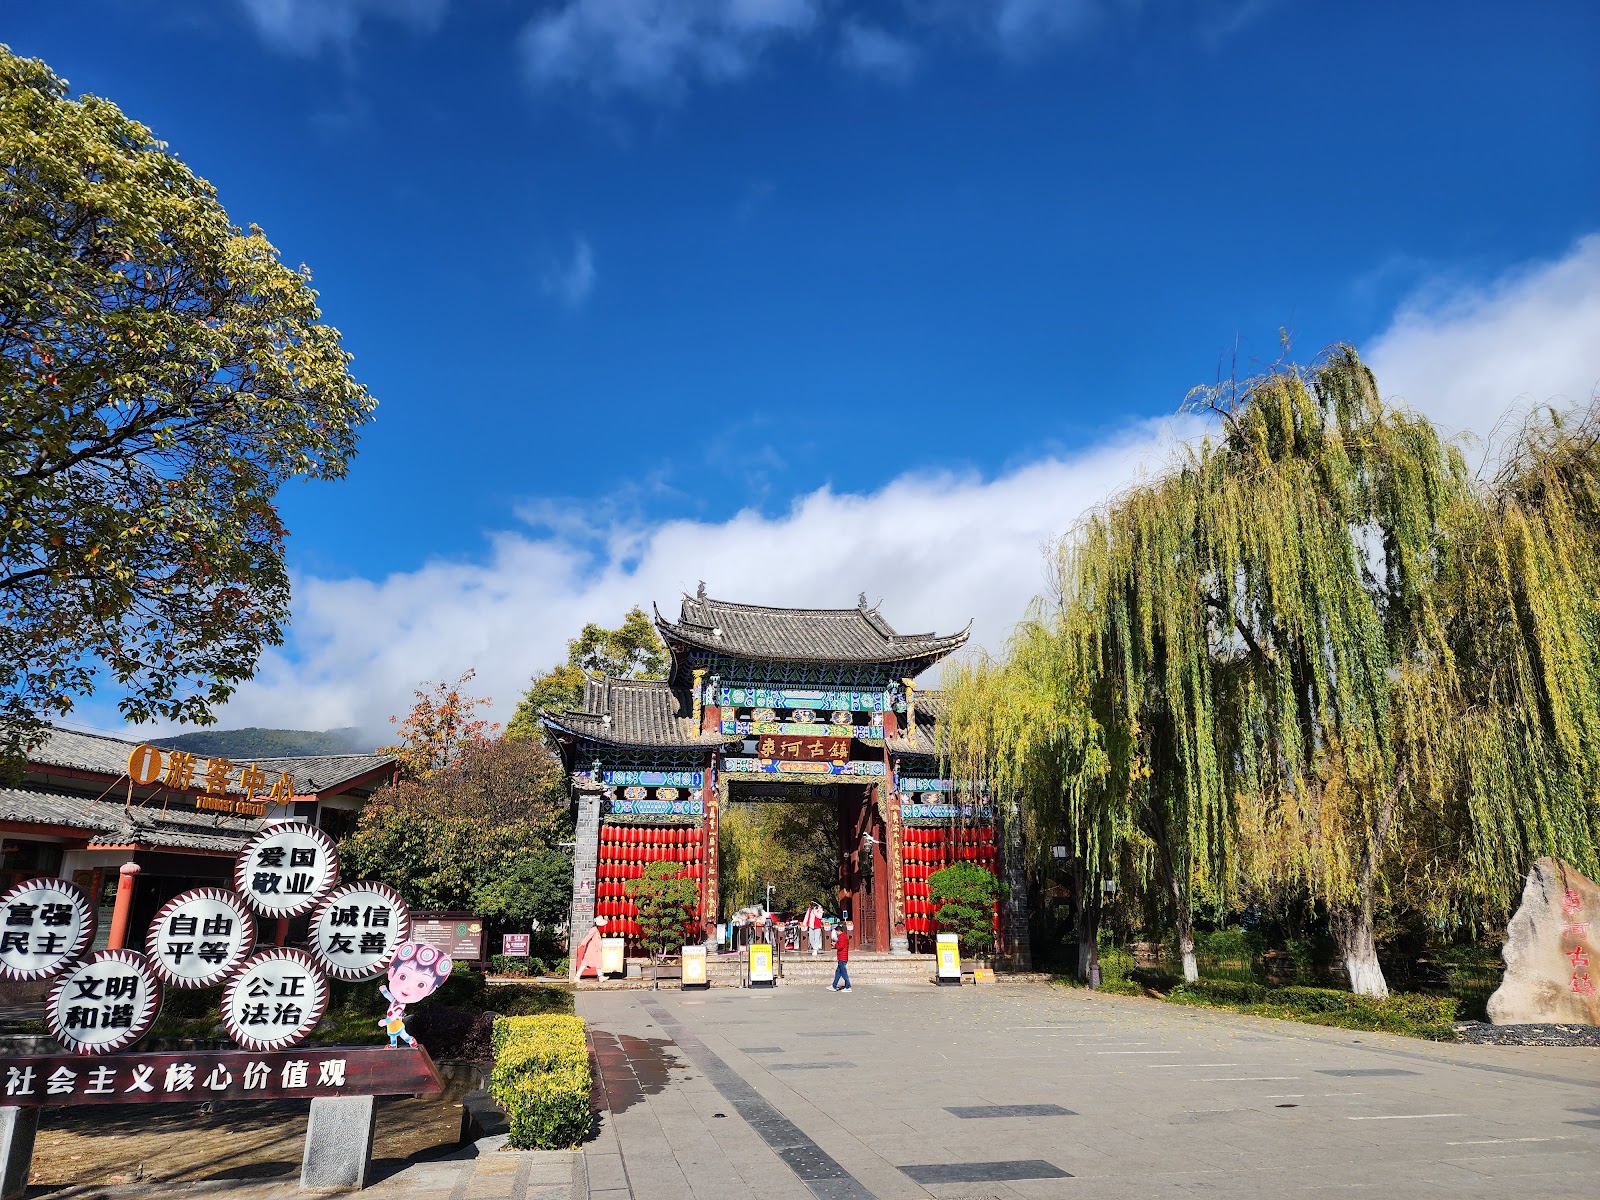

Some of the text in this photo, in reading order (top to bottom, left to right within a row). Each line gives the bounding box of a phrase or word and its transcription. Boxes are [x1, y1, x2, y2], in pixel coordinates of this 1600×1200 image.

[163, 750, 295, 805] 游客中心
[195, 795, 267, 816] TOURIST CENTER
[257, 846, 317, 867] 爱国
[252, 872, 314, 895] 敬业
[6, 902, 73, 926] 富强
[169, 913, 232, 936] 自由
[330, 905, 391, 927] 诚信
[0, 931, 67, 955] 民主
[164, 941, 230, 964] 平等
[326, 932, 387, 954] 友善
[70, 975, 139, 1000] 文明
[246, 976, 306, 997] 公正
[64, 1003, 134, 1029] 和谐
[239, 1003, 302, 1025] 法治
[5, 1059, 347, 1096] 社会主义核心价值观
